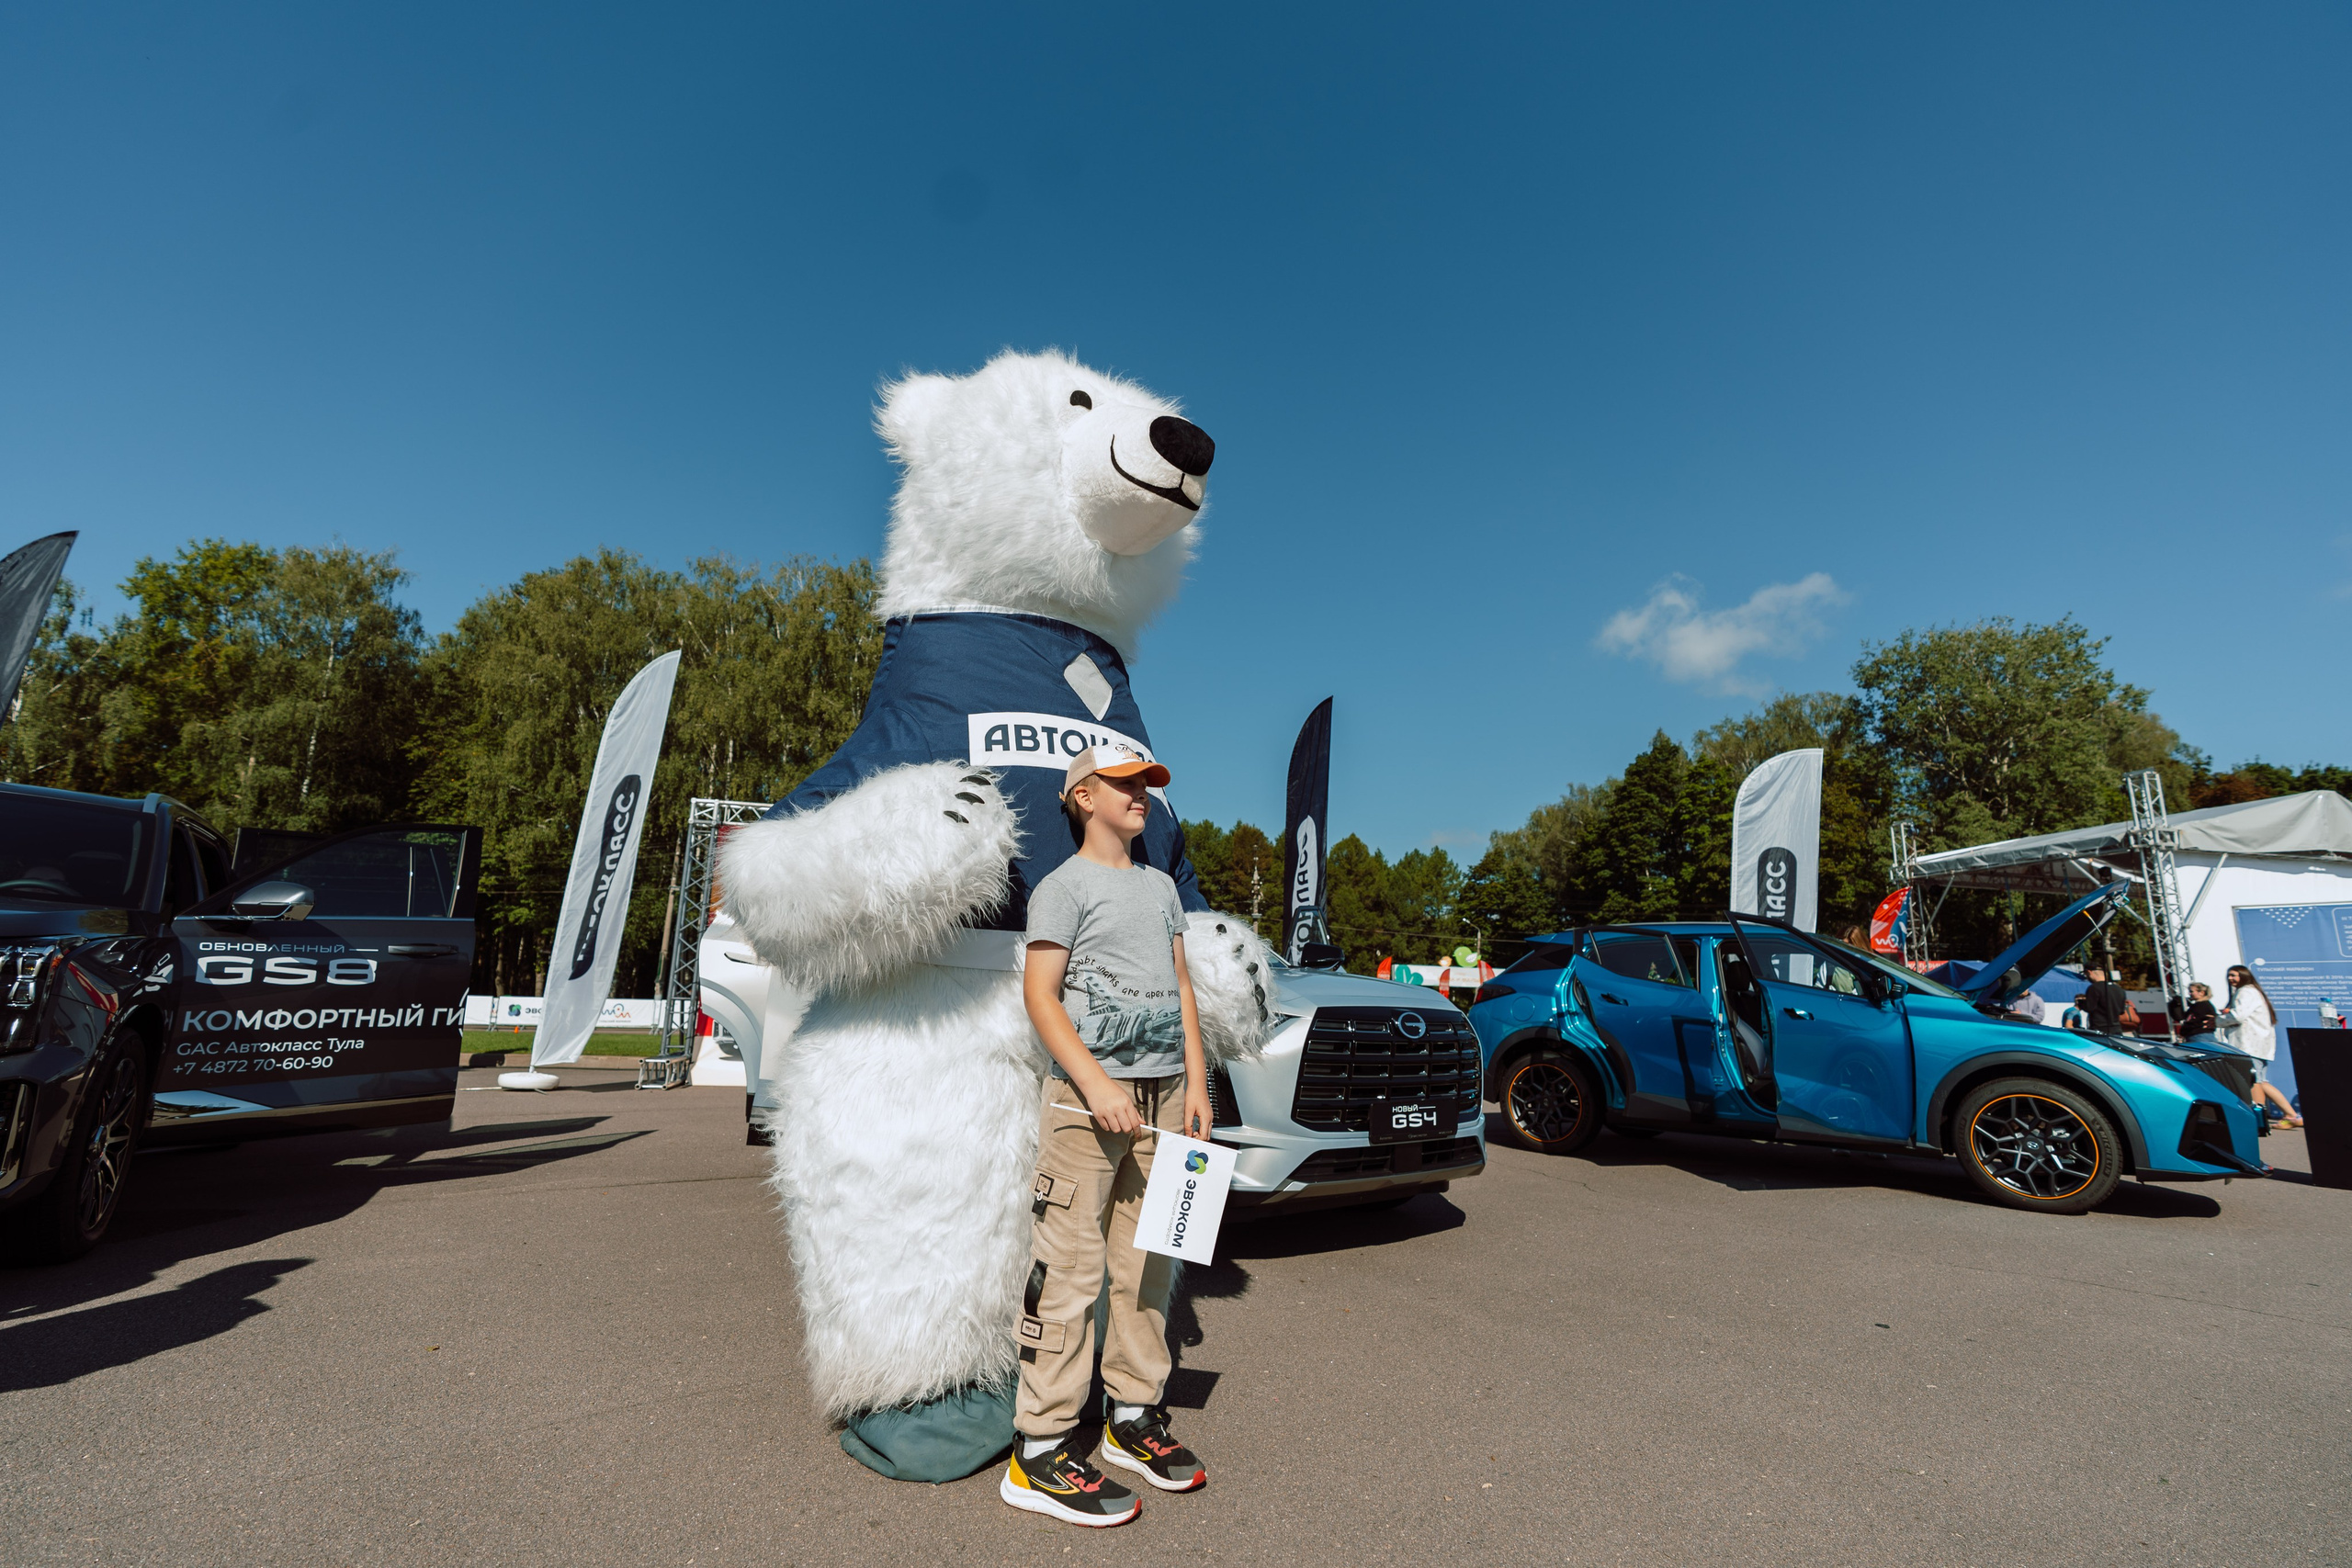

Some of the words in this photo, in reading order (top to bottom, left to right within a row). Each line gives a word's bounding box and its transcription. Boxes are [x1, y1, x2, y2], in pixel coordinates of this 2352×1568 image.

[198, 942, 345, 953] ОБНОВЛЕННЫЙ
[195, 955, 378, 986] GS8
[1122, 987, 1139, 998] are
[1145, 989, 1165, 999] apex
[182, 1003, 424, 1032] КОМФОРТНЫЙ
[176, 1042, 220, 1055] GAC
[224, 1039, 322, 1055] Автокласс
[327, 1037, 365, 1053] Тула
[173, 1061, 197, 1075] +7
[199, 1059, 248, 1074] 4872
[253, 1055, 334, 1072] 70-60-90
[1392, 1104, 1419, 1112] НОВЫЙ
[1392, 1111, 1437, 1129] GS4
[1171, 1179, 1197, 1248] ЭВОКОМ
[1055, 1451, 1069, 1464] FILA
